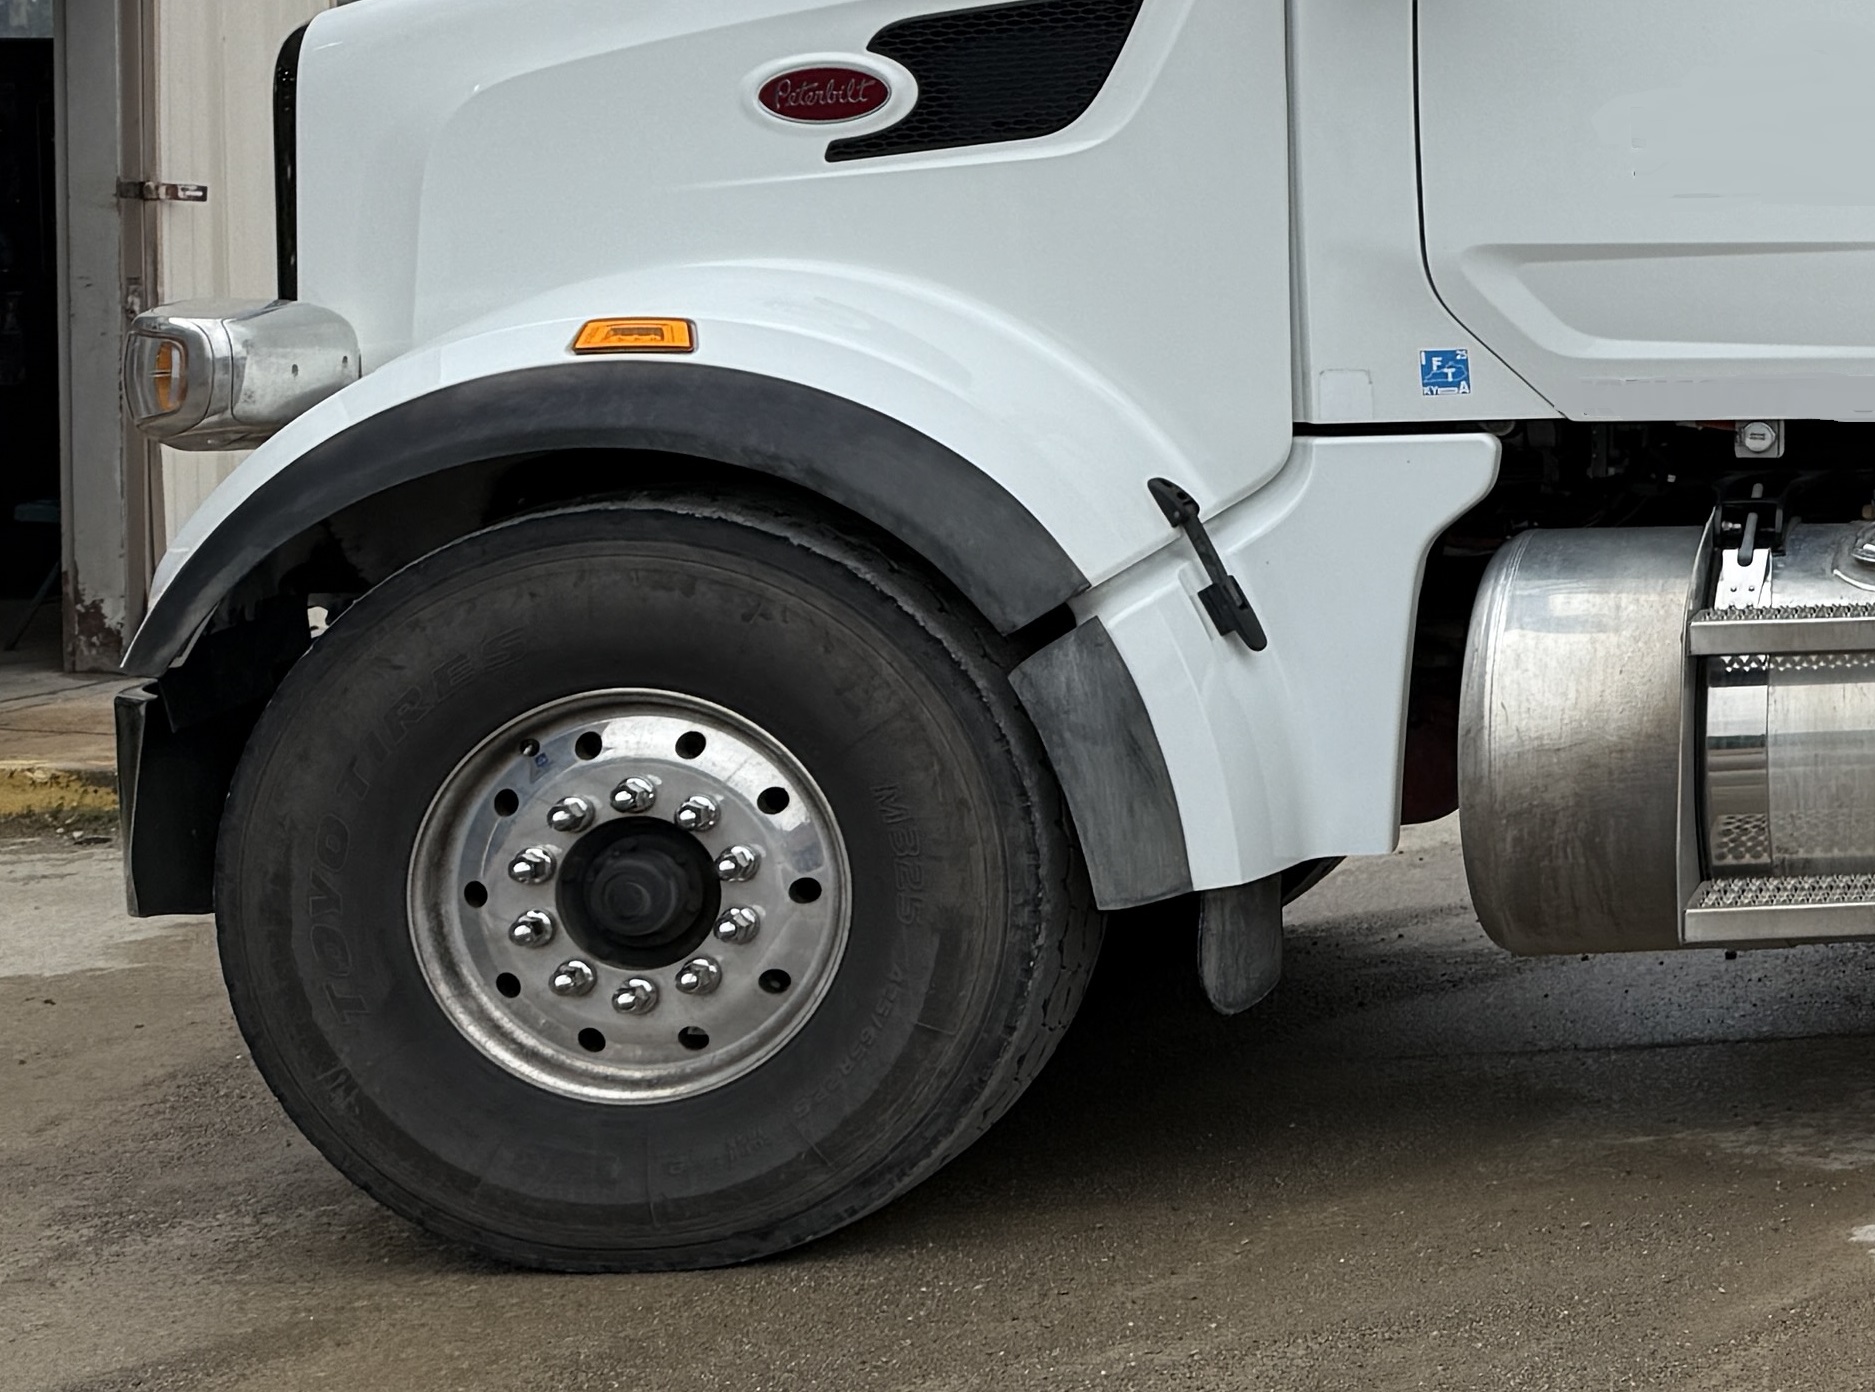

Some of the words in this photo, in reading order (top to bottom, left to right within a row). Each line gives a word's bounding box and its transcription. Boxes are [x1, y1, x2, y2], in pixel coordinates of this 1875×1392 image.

[776, 78, 876, 110] Peterbilt
[336, 626, 528, 801] TIRES
[310, 814, 371, 1026] TOYO
[870, 782, 927, 927] M325
